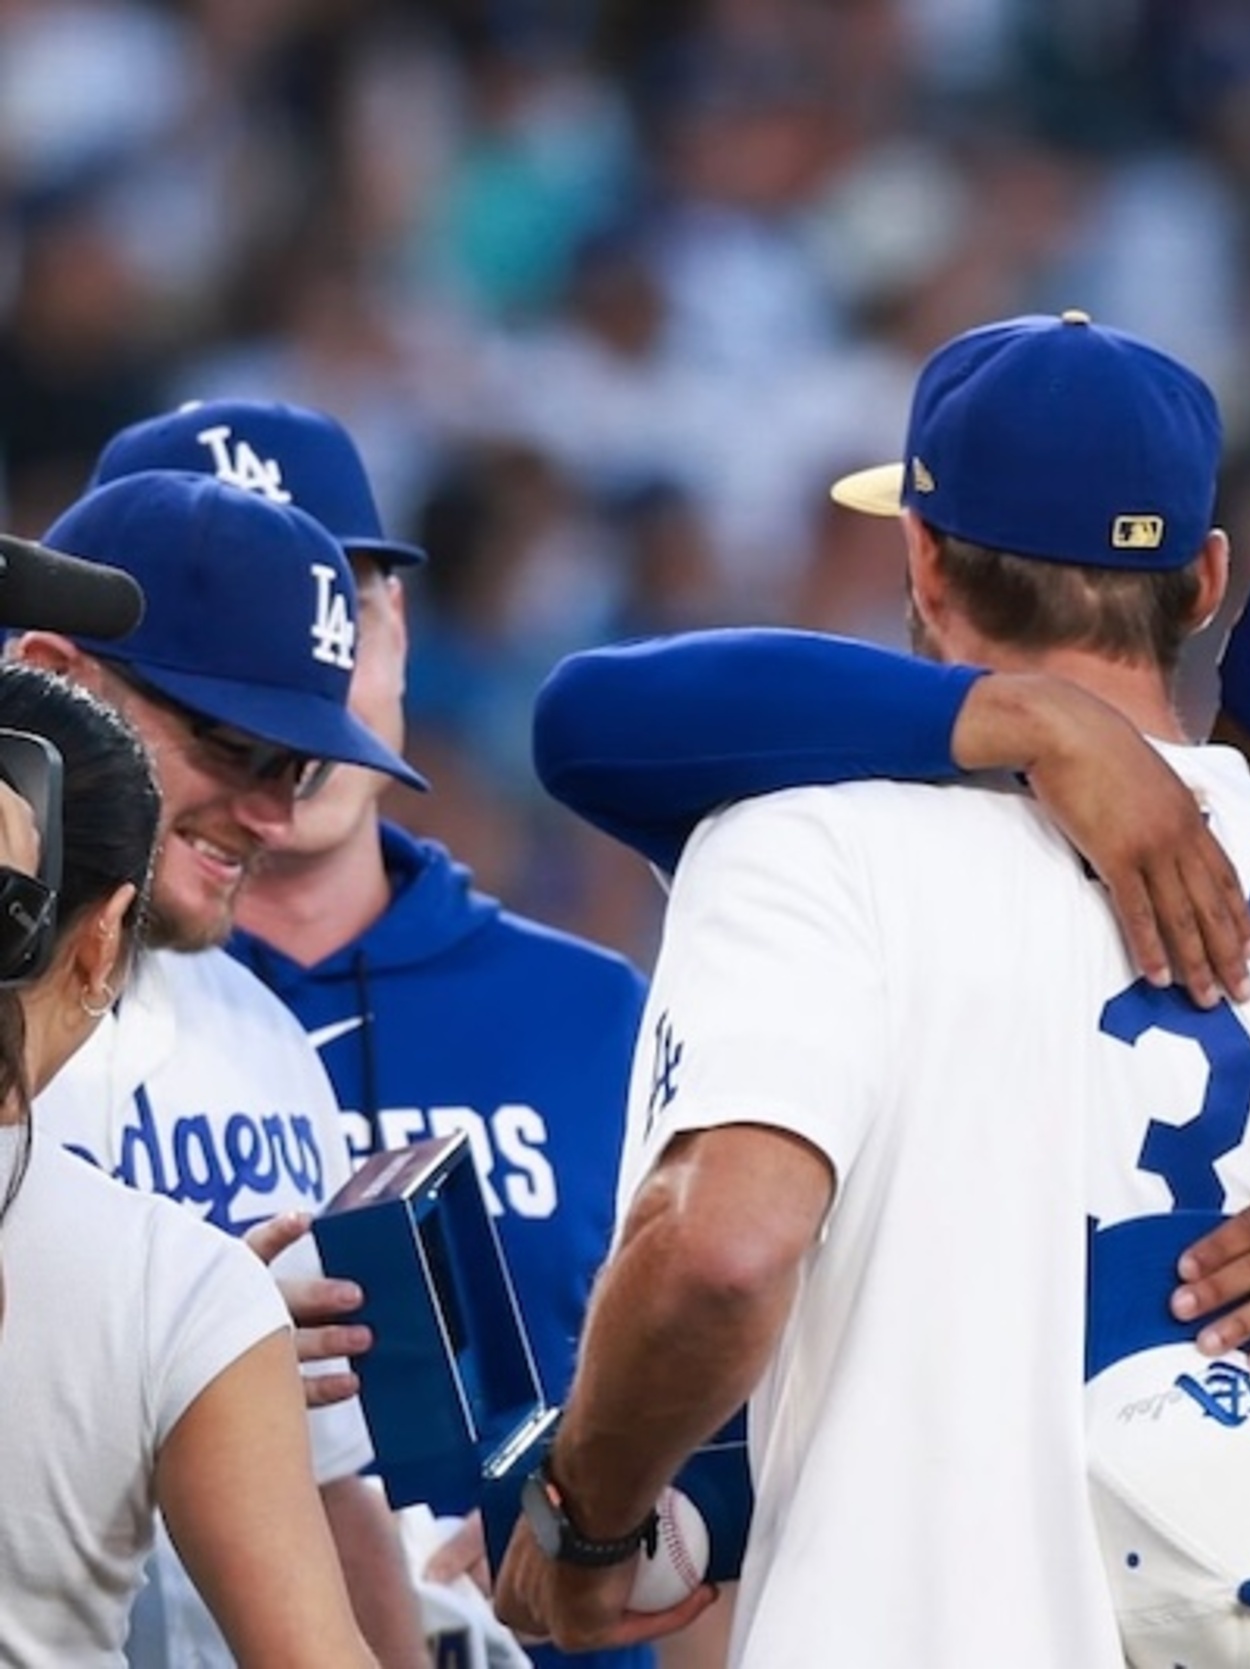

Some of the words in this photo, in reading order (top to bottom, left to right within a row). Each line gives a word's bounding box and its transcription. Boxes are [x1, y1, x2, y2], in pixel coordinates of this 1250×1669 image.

[197, 425, 292, 504] LA
[310, 563, 355, 670] LA
[62, 1082, 324, 1239] dgers
